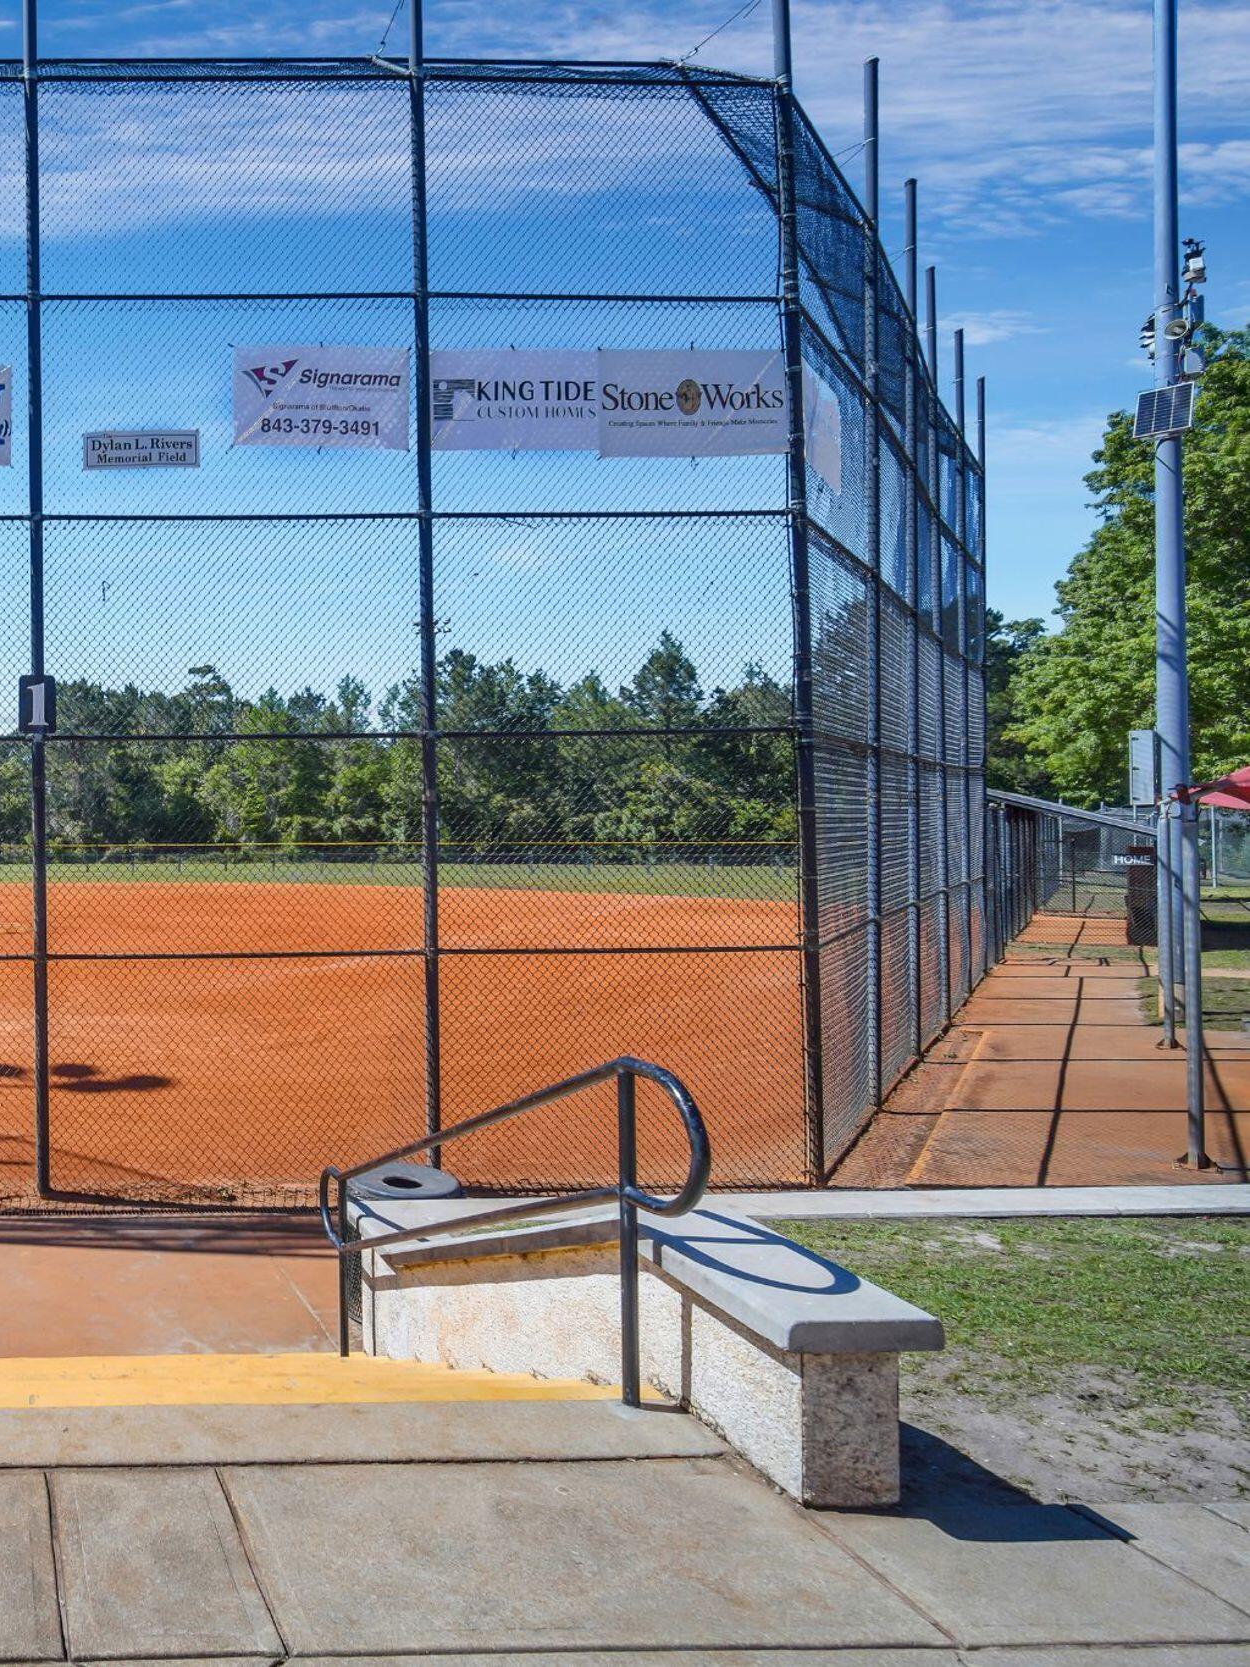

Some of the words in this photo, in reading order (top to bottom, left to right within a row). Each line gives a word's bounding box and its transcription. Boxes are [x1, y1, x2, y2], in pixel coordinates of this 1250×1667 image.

[299, 369, 401, 388] Signarama
[477, 380, 534, 401] KING
[539, 380, 596, 401] TIDE
[602, 383, 674, 412] Stone
[701, 382, 784, 411] Works
[477, 404, 539, 419] CUSTOM
[544, 404, 597, 419] HOMES
[261, 418, 380, 436] 843-379-3491
[91, 439, 132, 453] Dylan
[135, 439, 148, 450] L.
[150, 438, 193, 450] Rivers
[97, 452, 152, 464] Memorial
[158, 452, 186, 462] Field
[26, 682, 49, 726] 1
[1113, 855, 1151, 865] HOME
